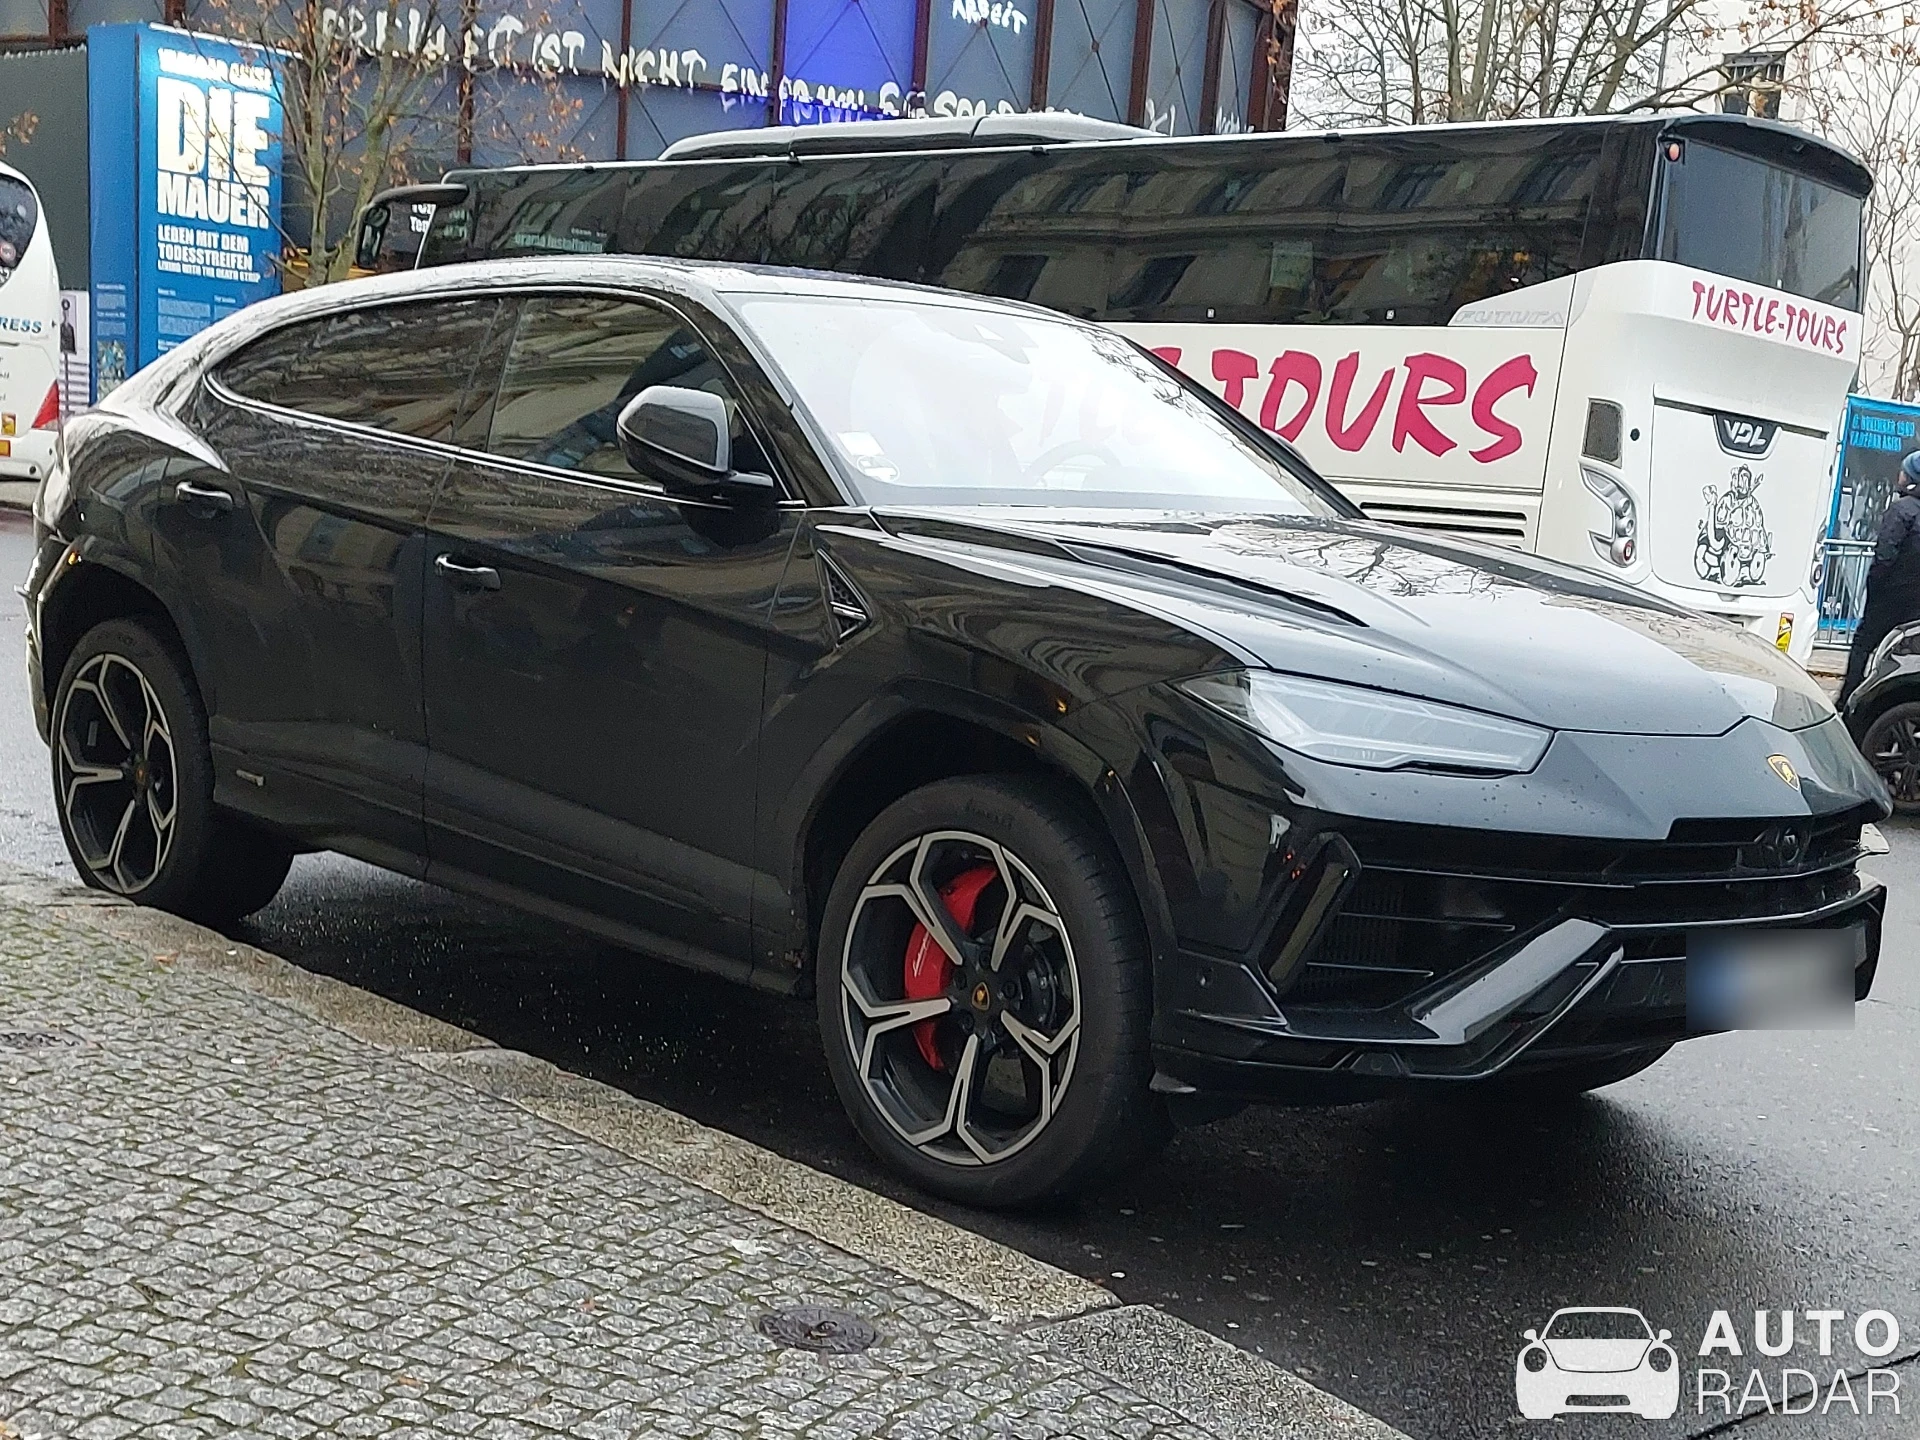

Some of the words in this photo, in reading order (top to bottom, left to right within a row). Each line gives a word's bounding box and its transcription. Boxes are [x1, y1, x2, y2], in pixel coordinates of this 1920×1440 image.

[531, 31, 586, 77] IST
[602, 39, 707, 89] NICHT
[721, 62, 768, 98] EIN
[157, 76, 270, 187] DIE
[157, 170, 270, 230] MAUER
[158, 241, 253, 272] TODESSTREIFEN
[196, 229, 220, 249] MIT
[221, 233, 249, 254] DEM
[1692, 280, 1847, 354] TURTLE-TOURS
[1723, 418, 1767, 447] VDL
